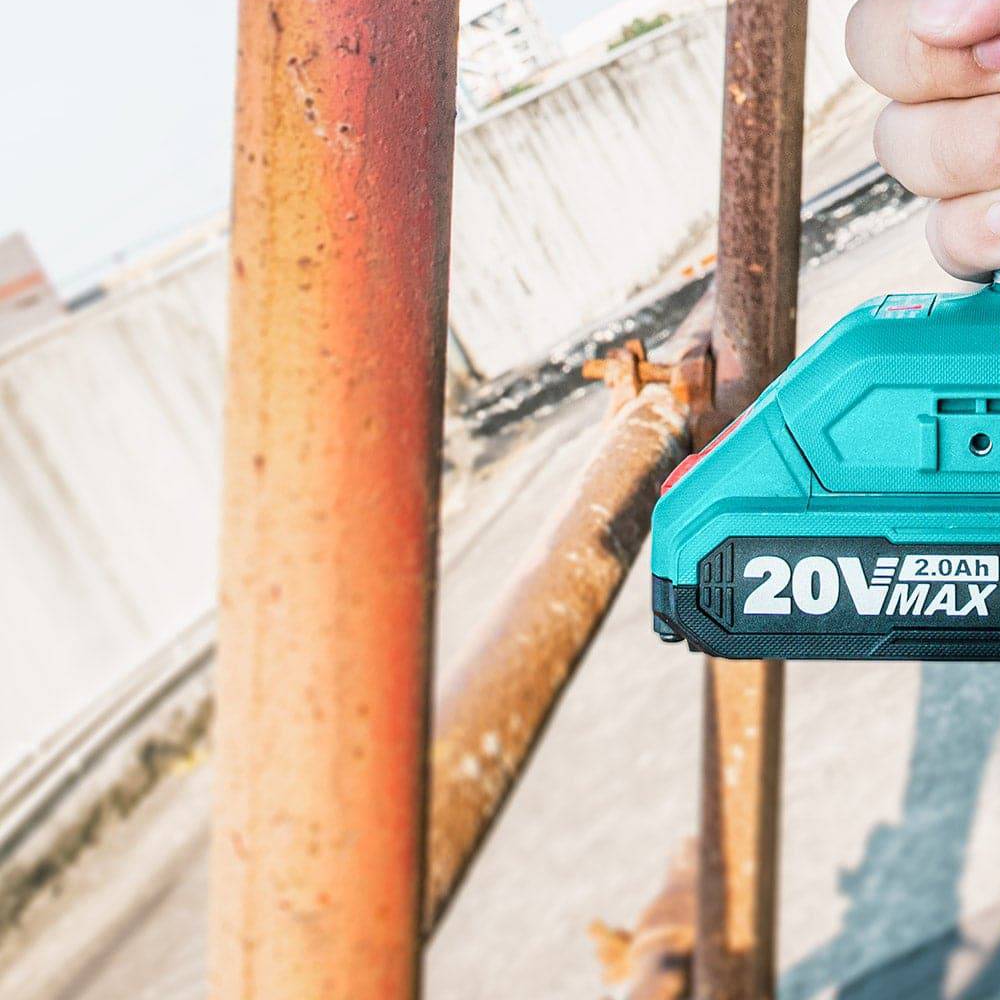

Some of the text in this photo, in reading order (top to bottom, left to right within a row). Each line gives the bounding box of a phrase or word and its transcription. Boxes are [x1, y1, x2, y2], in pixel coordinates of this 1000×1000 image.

[914, 558, 990, 577] 2.0Ah
[743, 555, 900, 616] 20V
[885, 583, 998, 616] MAX
